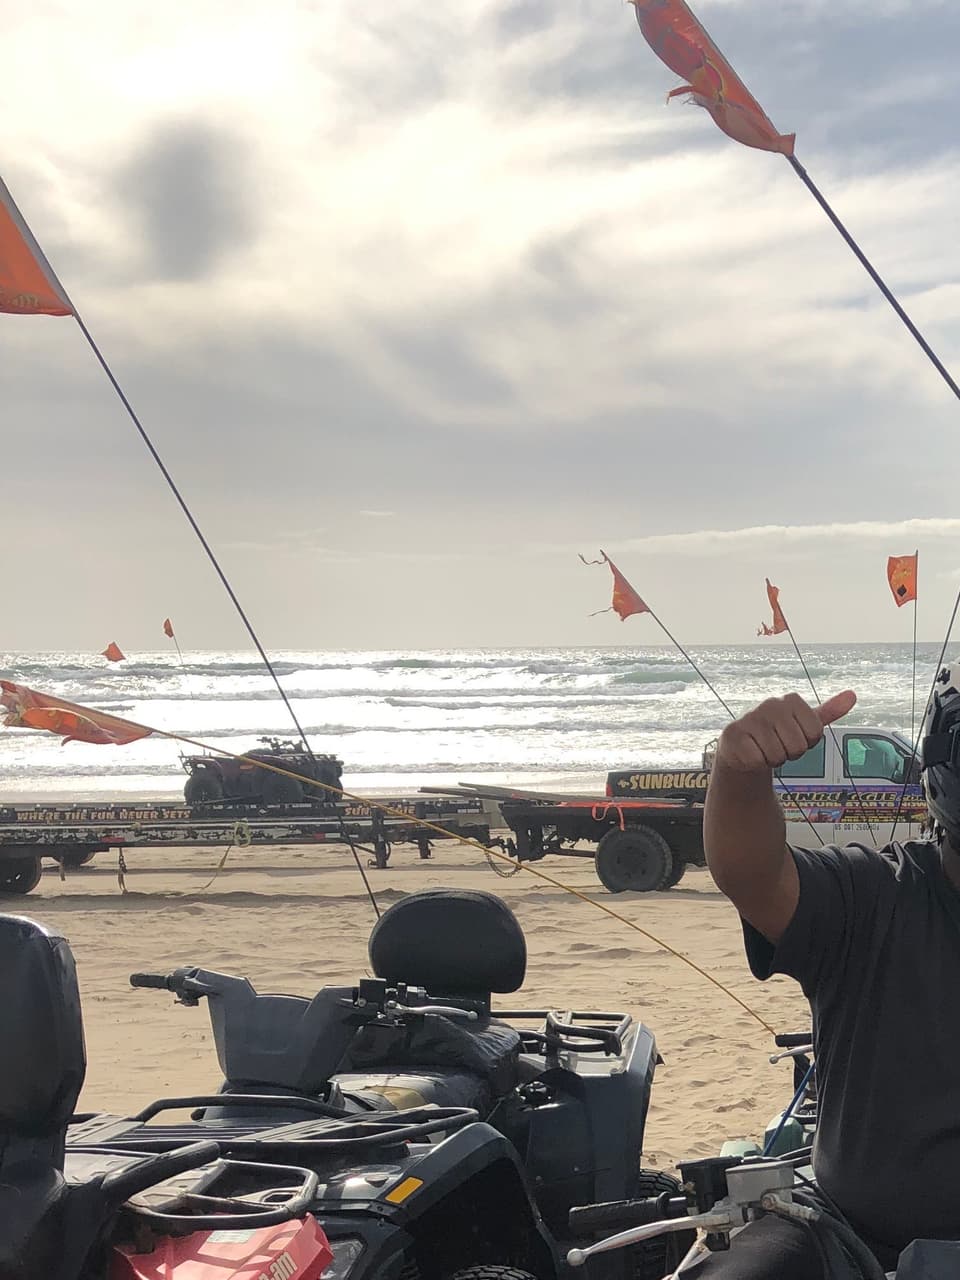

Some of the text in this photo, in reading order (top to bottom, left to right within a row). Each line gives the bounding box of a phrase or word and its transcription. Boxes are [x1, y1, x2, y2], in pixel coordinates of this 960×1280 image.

[16, 808, 191, 821] WHERE THE FUN NEVER SETS
